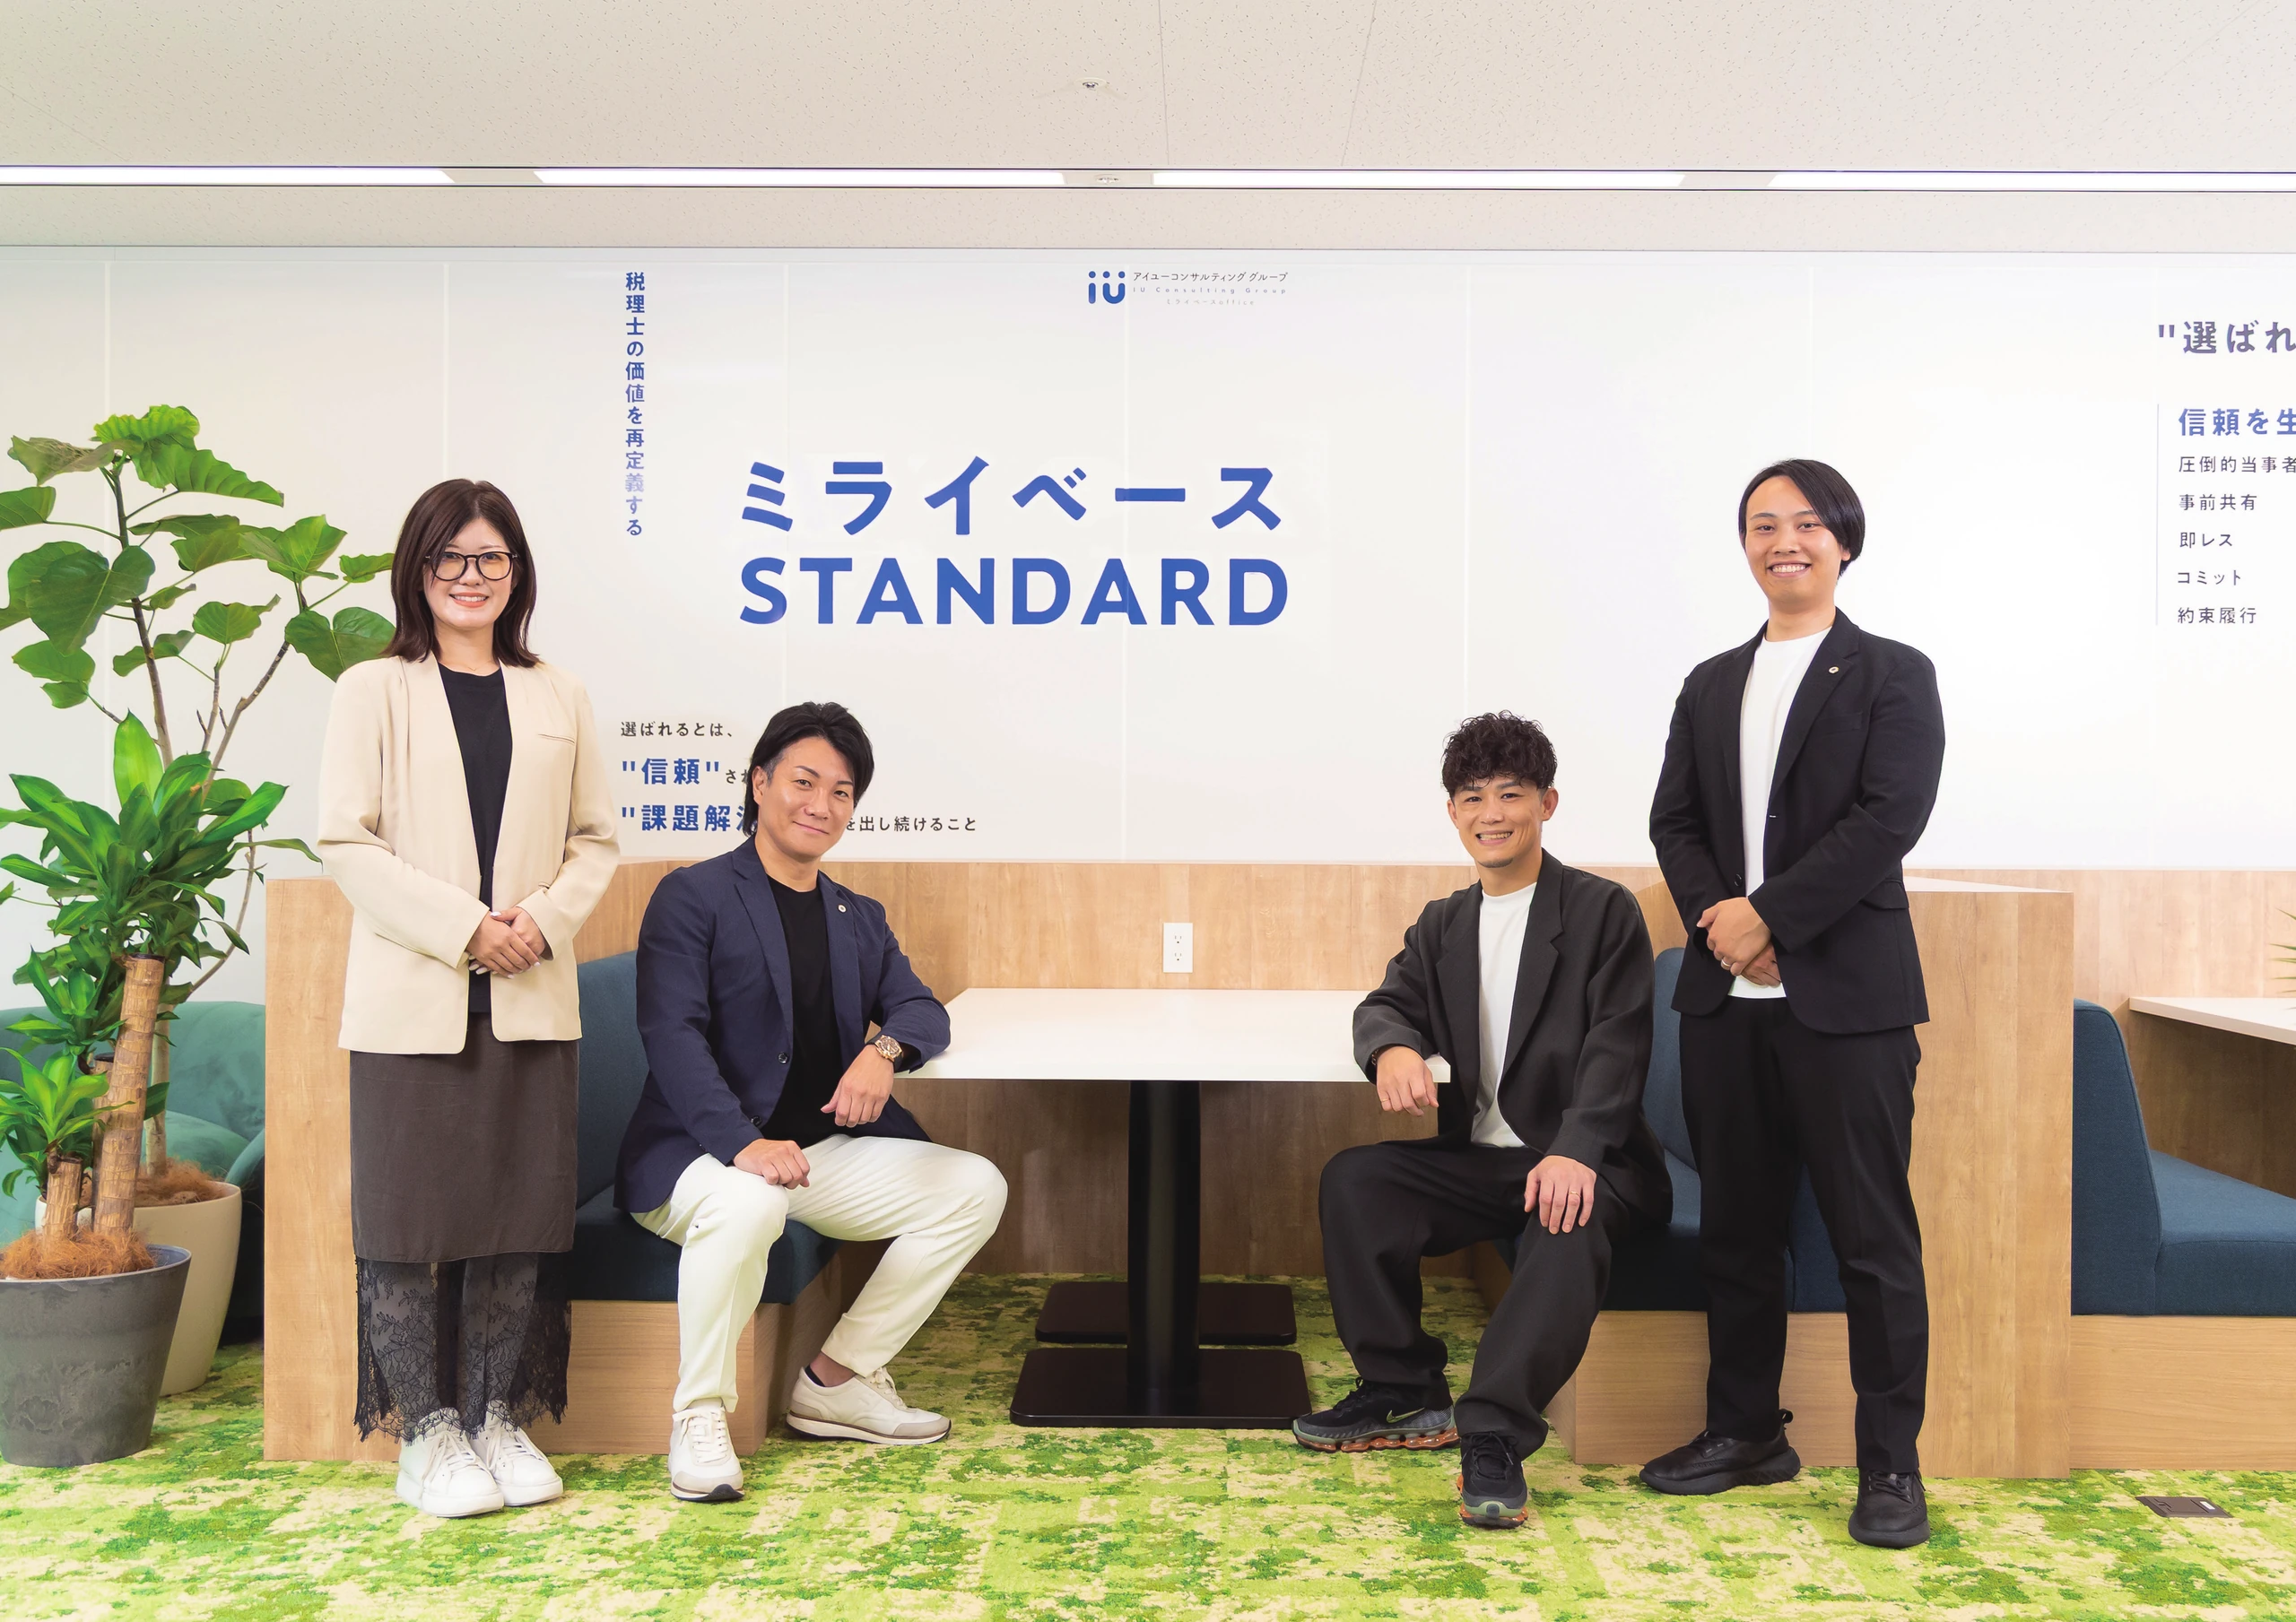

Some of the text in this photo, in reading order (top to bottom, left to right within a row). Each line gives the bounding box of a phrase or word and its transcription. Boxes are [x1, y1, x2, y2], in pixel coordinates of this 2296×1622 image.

[1249, 272, 1289, 282] グループ
[625, 272, 645, 536] 税理士の価値を再定義する
[2179, 455, 2296, 473] 圧倒的当事者
[742, 455, 1282, 535] ミライベース
[2179, 494, 2257, 511] 事前共有
[2179, 532, 2233, 549] 即レス
[2178, 569, 2241, 585] コミット
[739, 557, 1289, 626] STANDARD
[2178, 607, 2257, 624] 約束履行
[621, 721, 733, 737] 選ばれるとは、
[846, 816, 976, 832] を出し続けること
